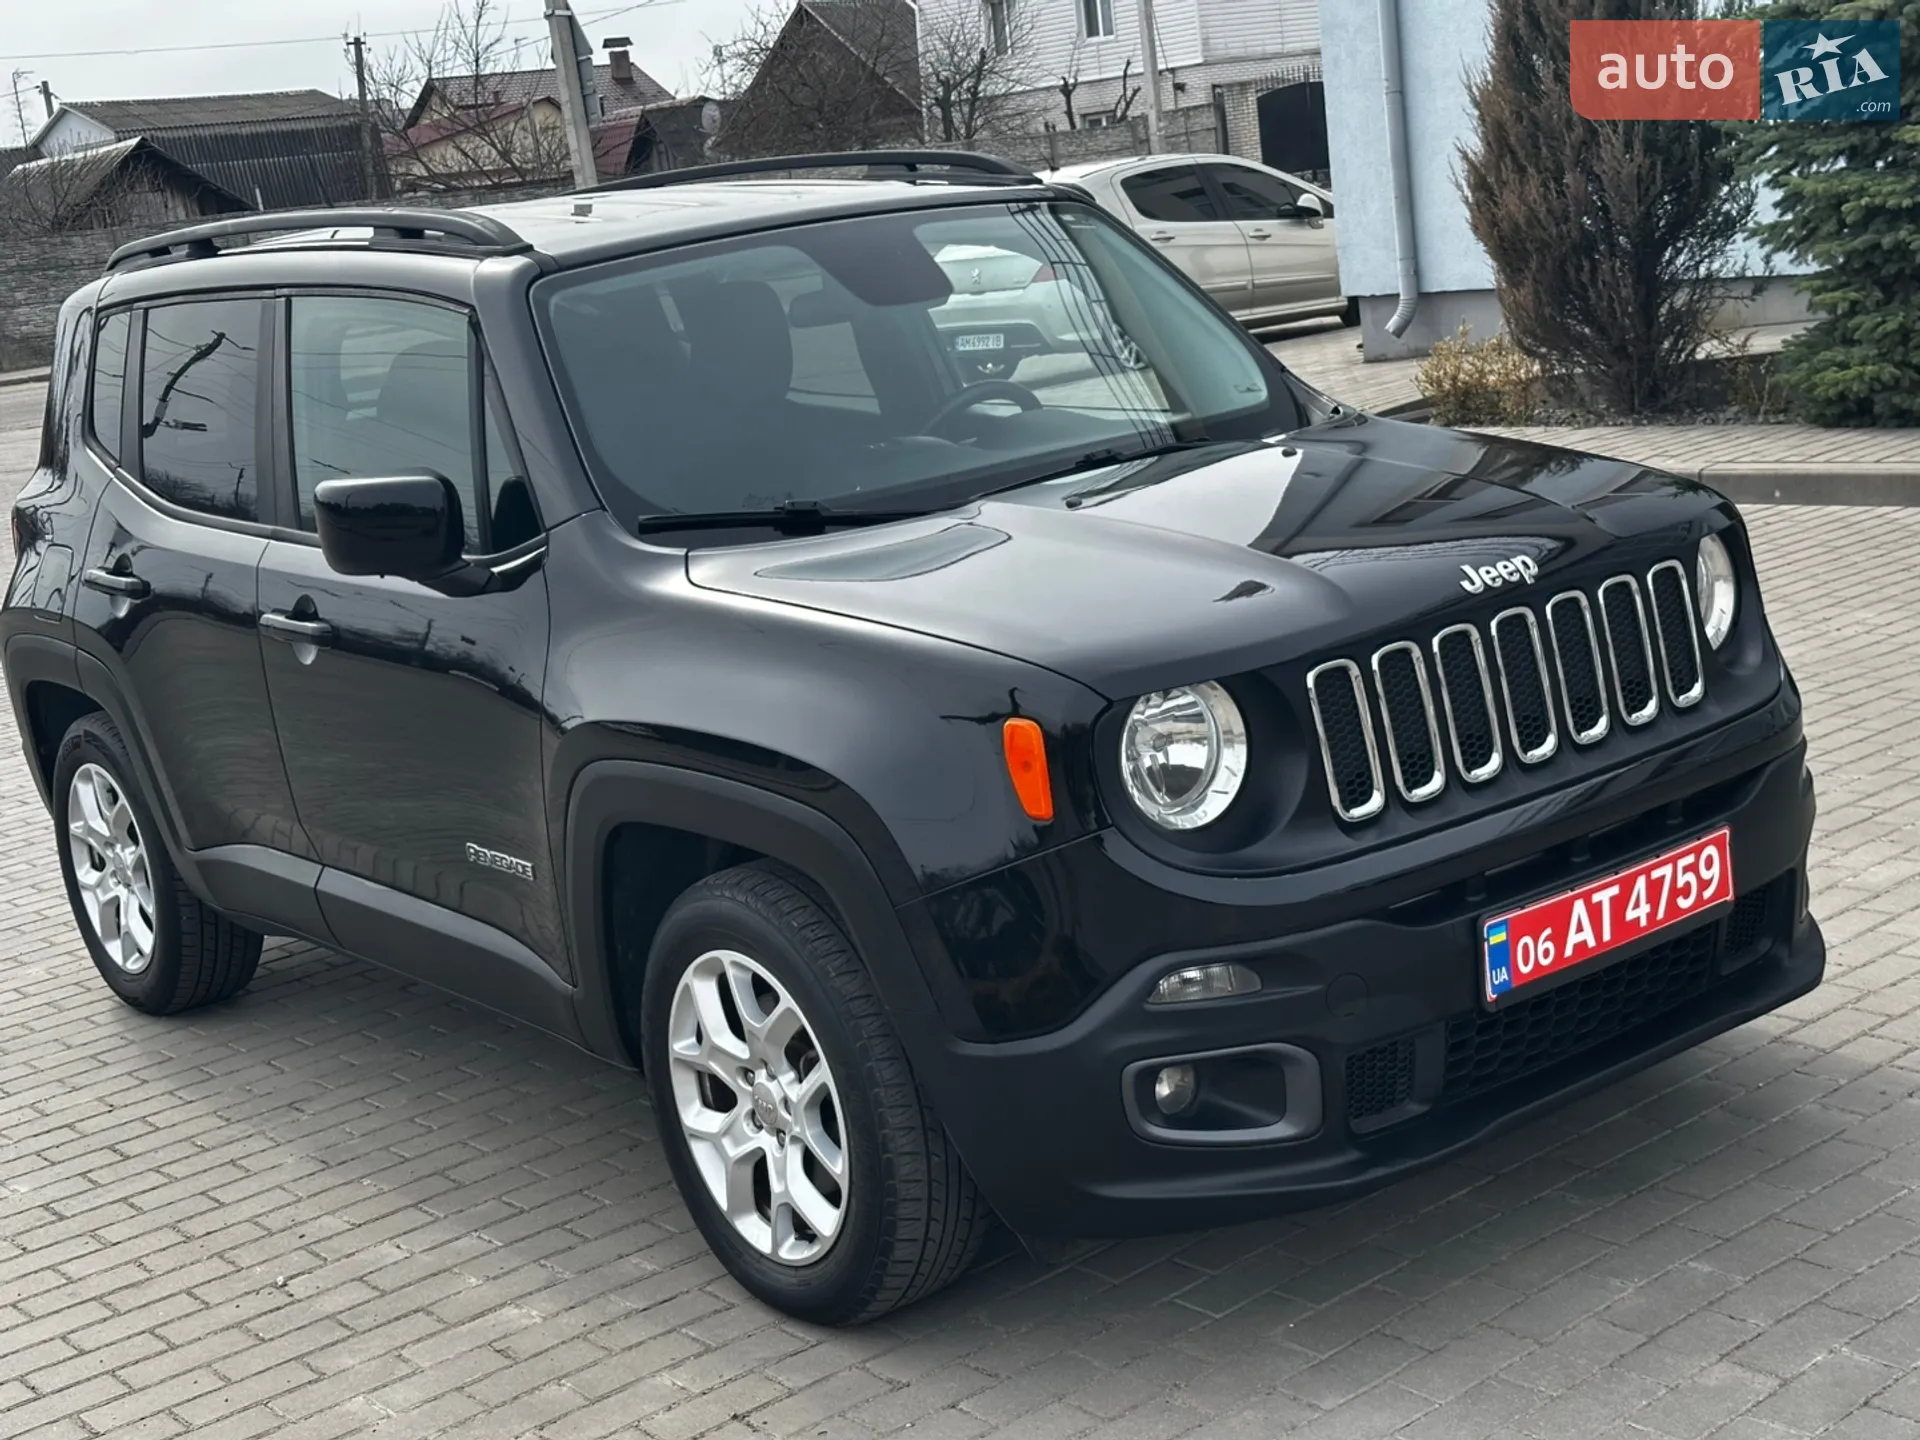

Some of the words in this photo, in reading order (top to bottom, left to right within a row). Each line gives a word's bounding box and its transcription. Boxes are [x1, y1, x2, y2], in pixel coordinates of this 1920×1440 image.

[1460, 554, 1539, 594] Jeep
[1516, 927, 1555, 974] 06
[1563, 884, 1620, 958] AT
[1624, 844, 1720, 928] 4759
[1492, 966, 1508, 985] UA
